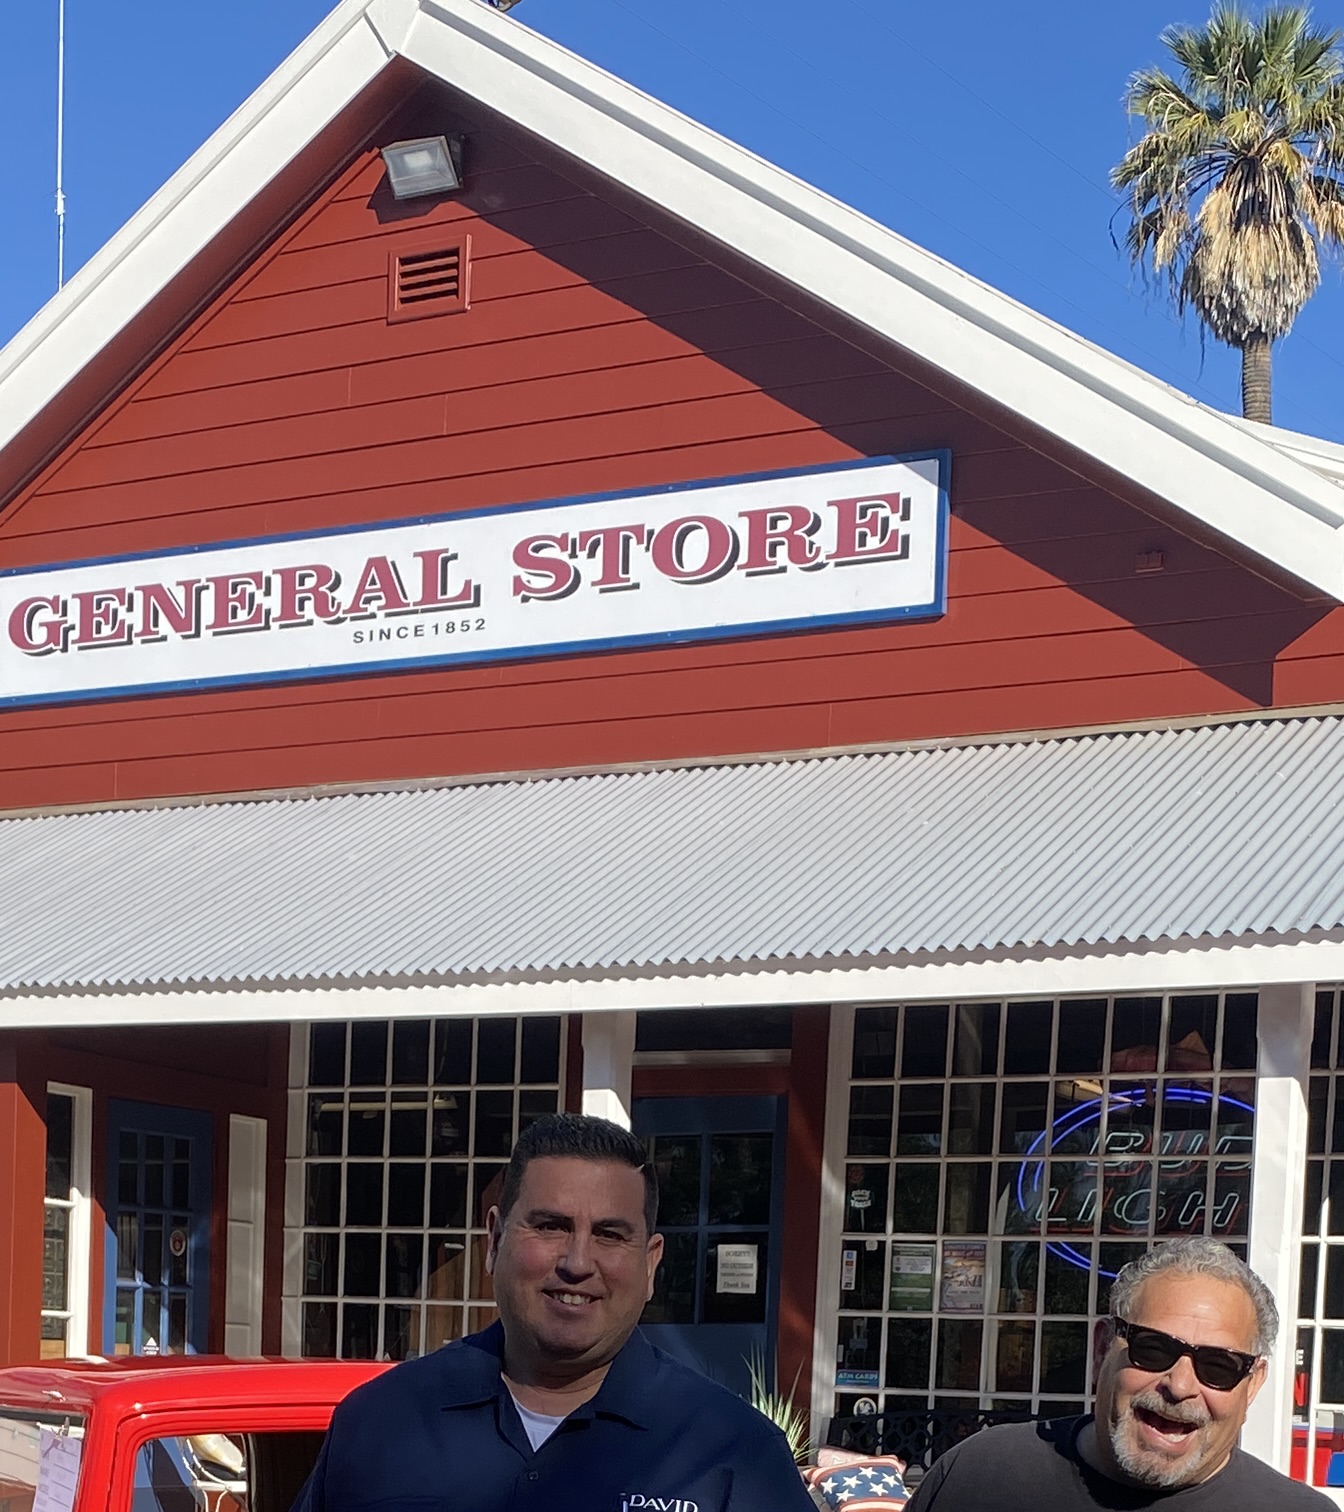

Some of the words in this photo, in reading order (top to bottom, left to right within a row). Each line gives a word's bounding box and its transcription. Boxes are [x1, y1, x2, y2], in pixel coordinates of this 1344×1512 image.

[8, 547, 482, 656] GENERAL
[512, 491, 912, 603] STORE
[1034, 1187, 1241, 1228] LIGH
